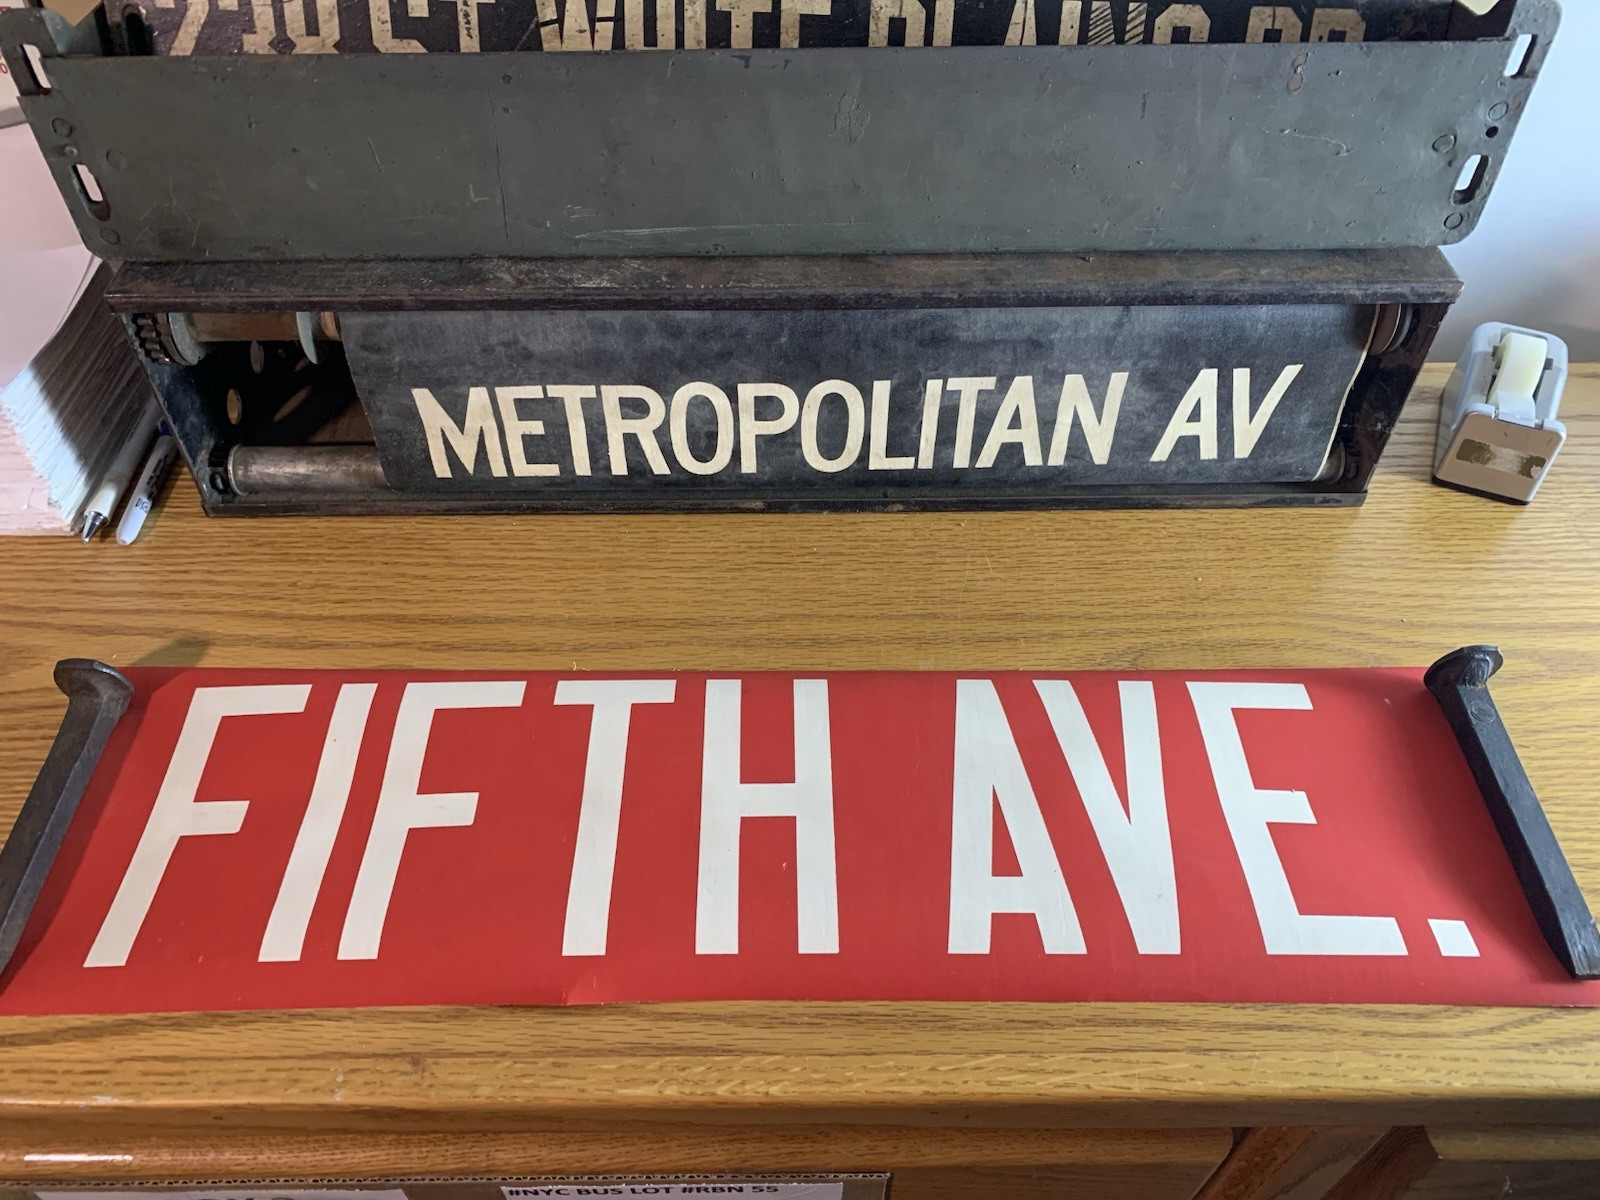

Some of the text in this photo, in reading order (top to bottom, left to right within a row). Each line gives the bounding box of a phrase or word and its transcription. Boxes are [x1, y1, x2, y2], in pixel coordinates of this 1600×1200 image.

[411, 364, 1303, 478] METROPOLITAN AV
[83, 679, 1480, 968] FIFTH AVE.
[507, 1185, 780, 1197] #NYC BUS LOT #RBN 55
